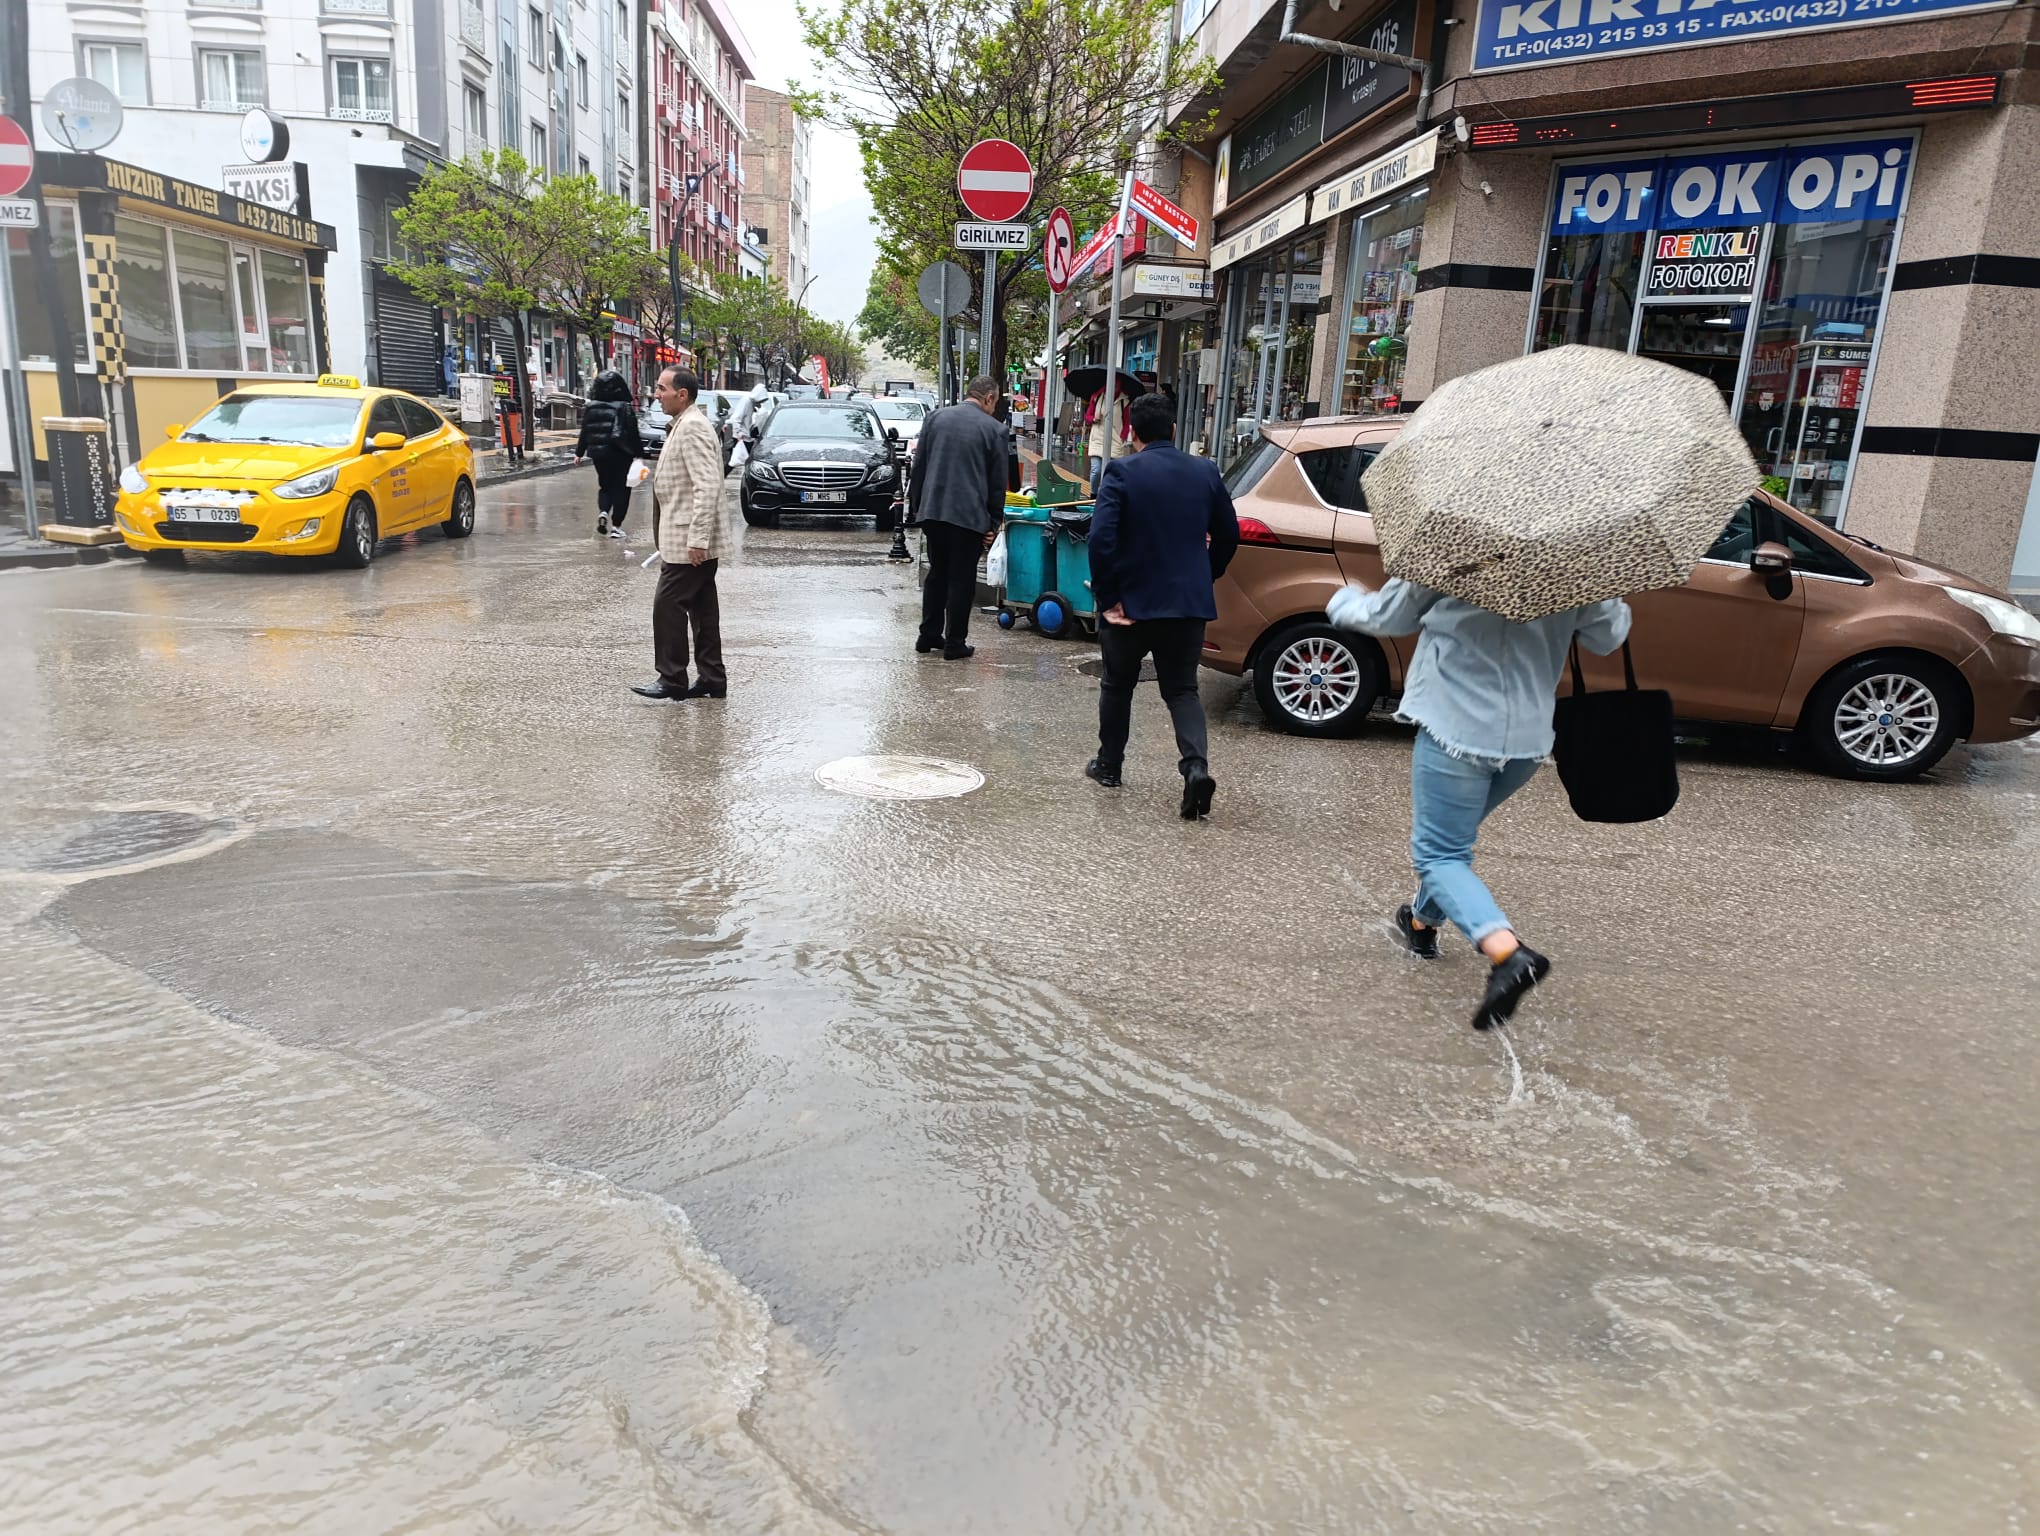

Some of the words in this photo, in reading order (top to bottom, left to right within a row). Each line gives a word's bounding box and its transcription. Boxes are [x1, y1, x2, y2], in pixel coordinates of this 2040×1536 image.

[1493, 32, 1593, 59] TLF:0(432)
[1599, 27, 1636, 45] 215
[1642, 22, 1668, 36] 93
[1674, 19, 1701, 34] 15
[1720, 0, 1847, 29] FAX:0(432)
[1497, 0, 1757, 38] KIR
[58, 85, 111, 113] Atlanta
[105, 161, 165, 201] HUZUR
[236, 202, 267, 230] 0432
[270, 211, 289, 236] 216
[292, 218, 303, 240] 11
[305, 223, 318, 243] 66
[1328, 189, 1341, 211] VAN
[0, 206, 32, 220] MEZ
[959, 226, 1025, 244] GİRİLMEZ
[174, 508, 187, 519] 65
[195, 509, 201, 520] T
[210, 510, 238, 521] 0239
